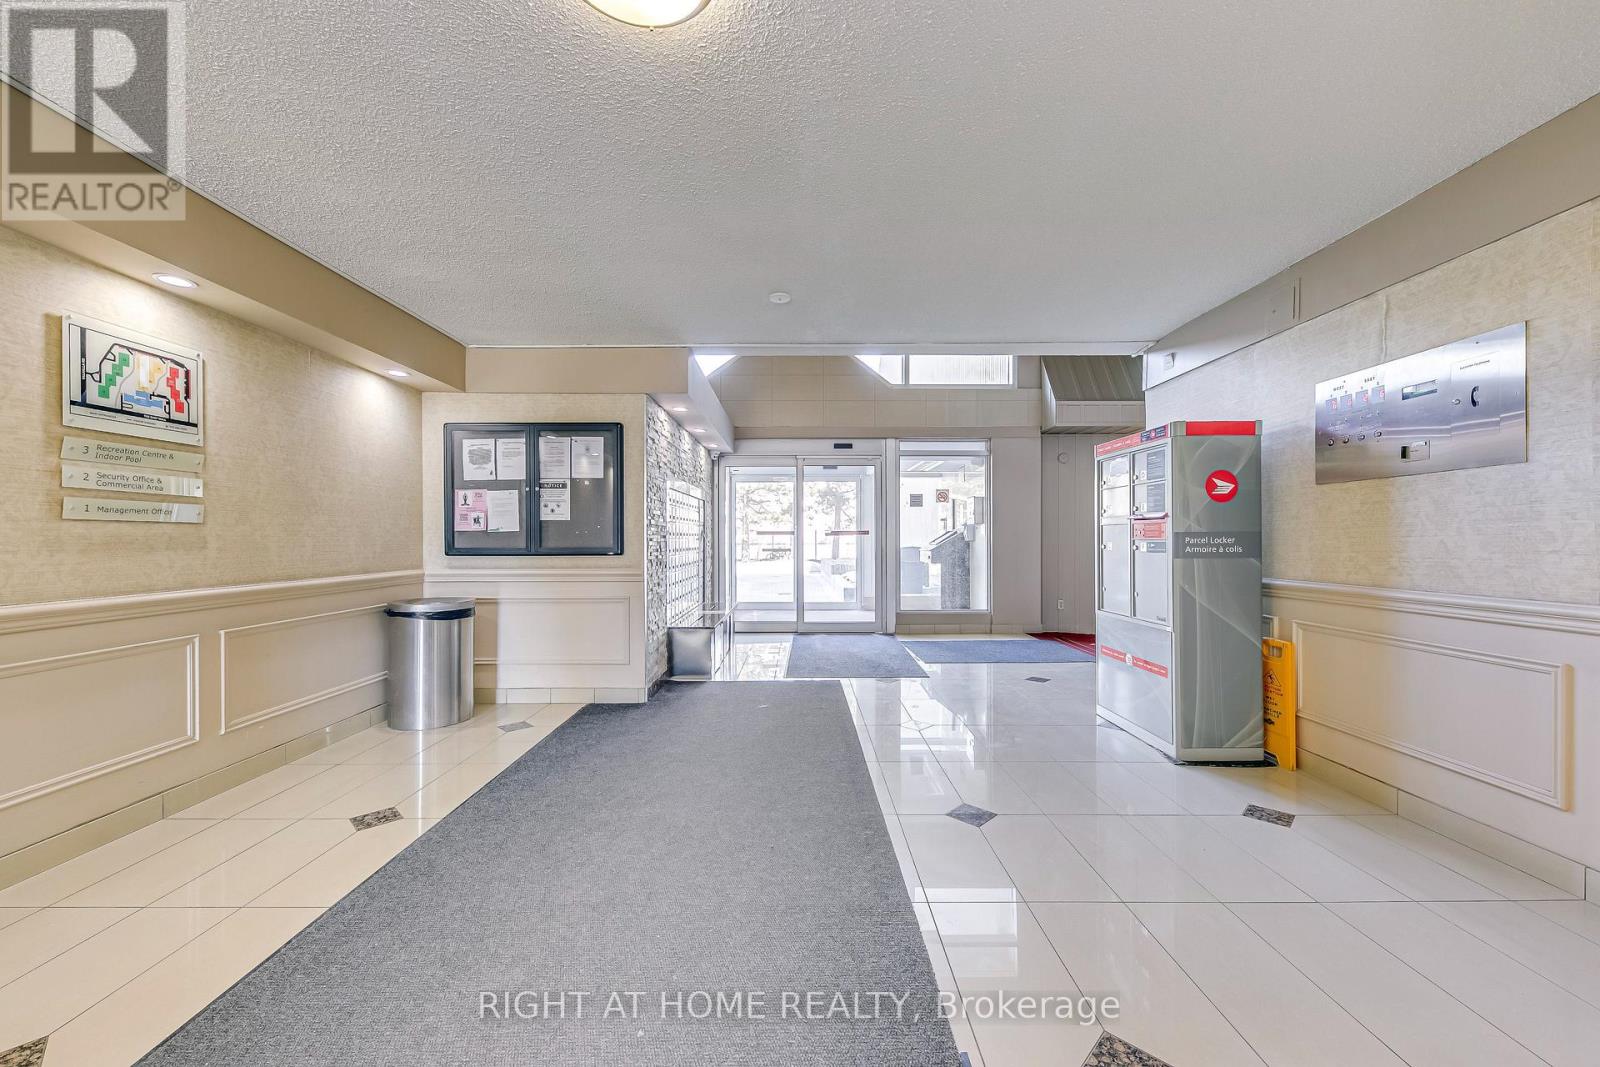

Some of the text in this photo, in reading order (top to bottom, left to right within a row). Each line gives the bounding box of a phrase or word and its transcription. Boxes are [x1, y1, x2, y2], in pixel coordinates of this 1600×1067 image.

[82, 445, 89, 454] 3
[96, 444, 140, 455] Recreation
[142, 449, 167, 459] Centre
[95, 452, 142, 463] Indoor Pool
[83, 472, 89, 481] 2
[96, 471, 130, 482] Security
[132, 475, 155, 483] Office
[96, 480, 145, 490] Commercial
[84, 504, 173, 515] 1 Management Offce
[1185, 536, 1235, 544] Parcel Locker
[1218, 545, 1224, 553] à
[1225, 545, 1243, 553] colis
